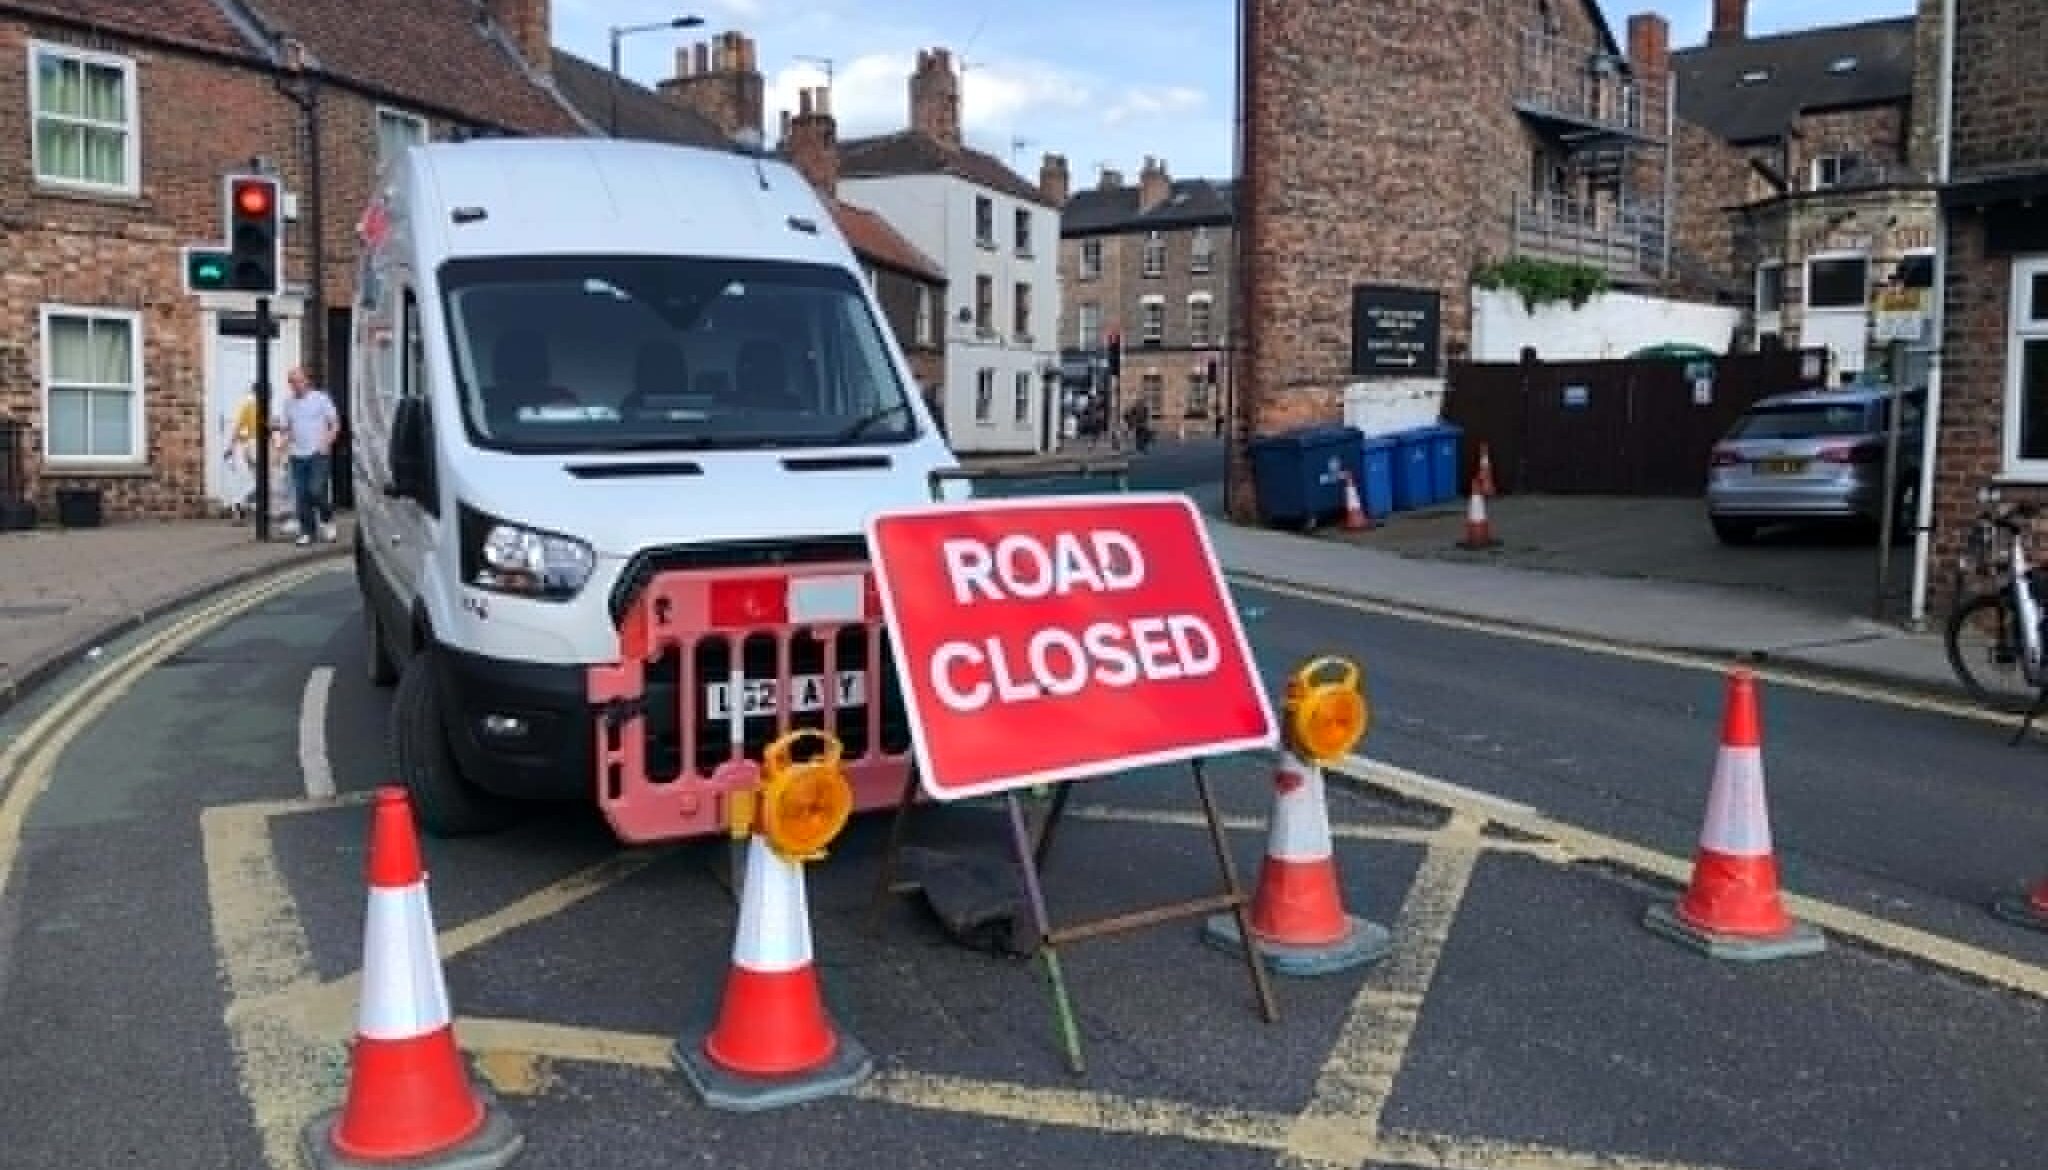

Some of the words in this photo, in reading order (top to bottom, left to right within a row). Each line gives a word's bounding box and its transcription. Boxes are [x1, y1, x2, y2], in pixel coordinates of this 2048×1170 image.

[943, 529, 1146, 606] ROAD
[802, 673, 858, 705] AY
[929, 614, 1222, 712] CLOSED
